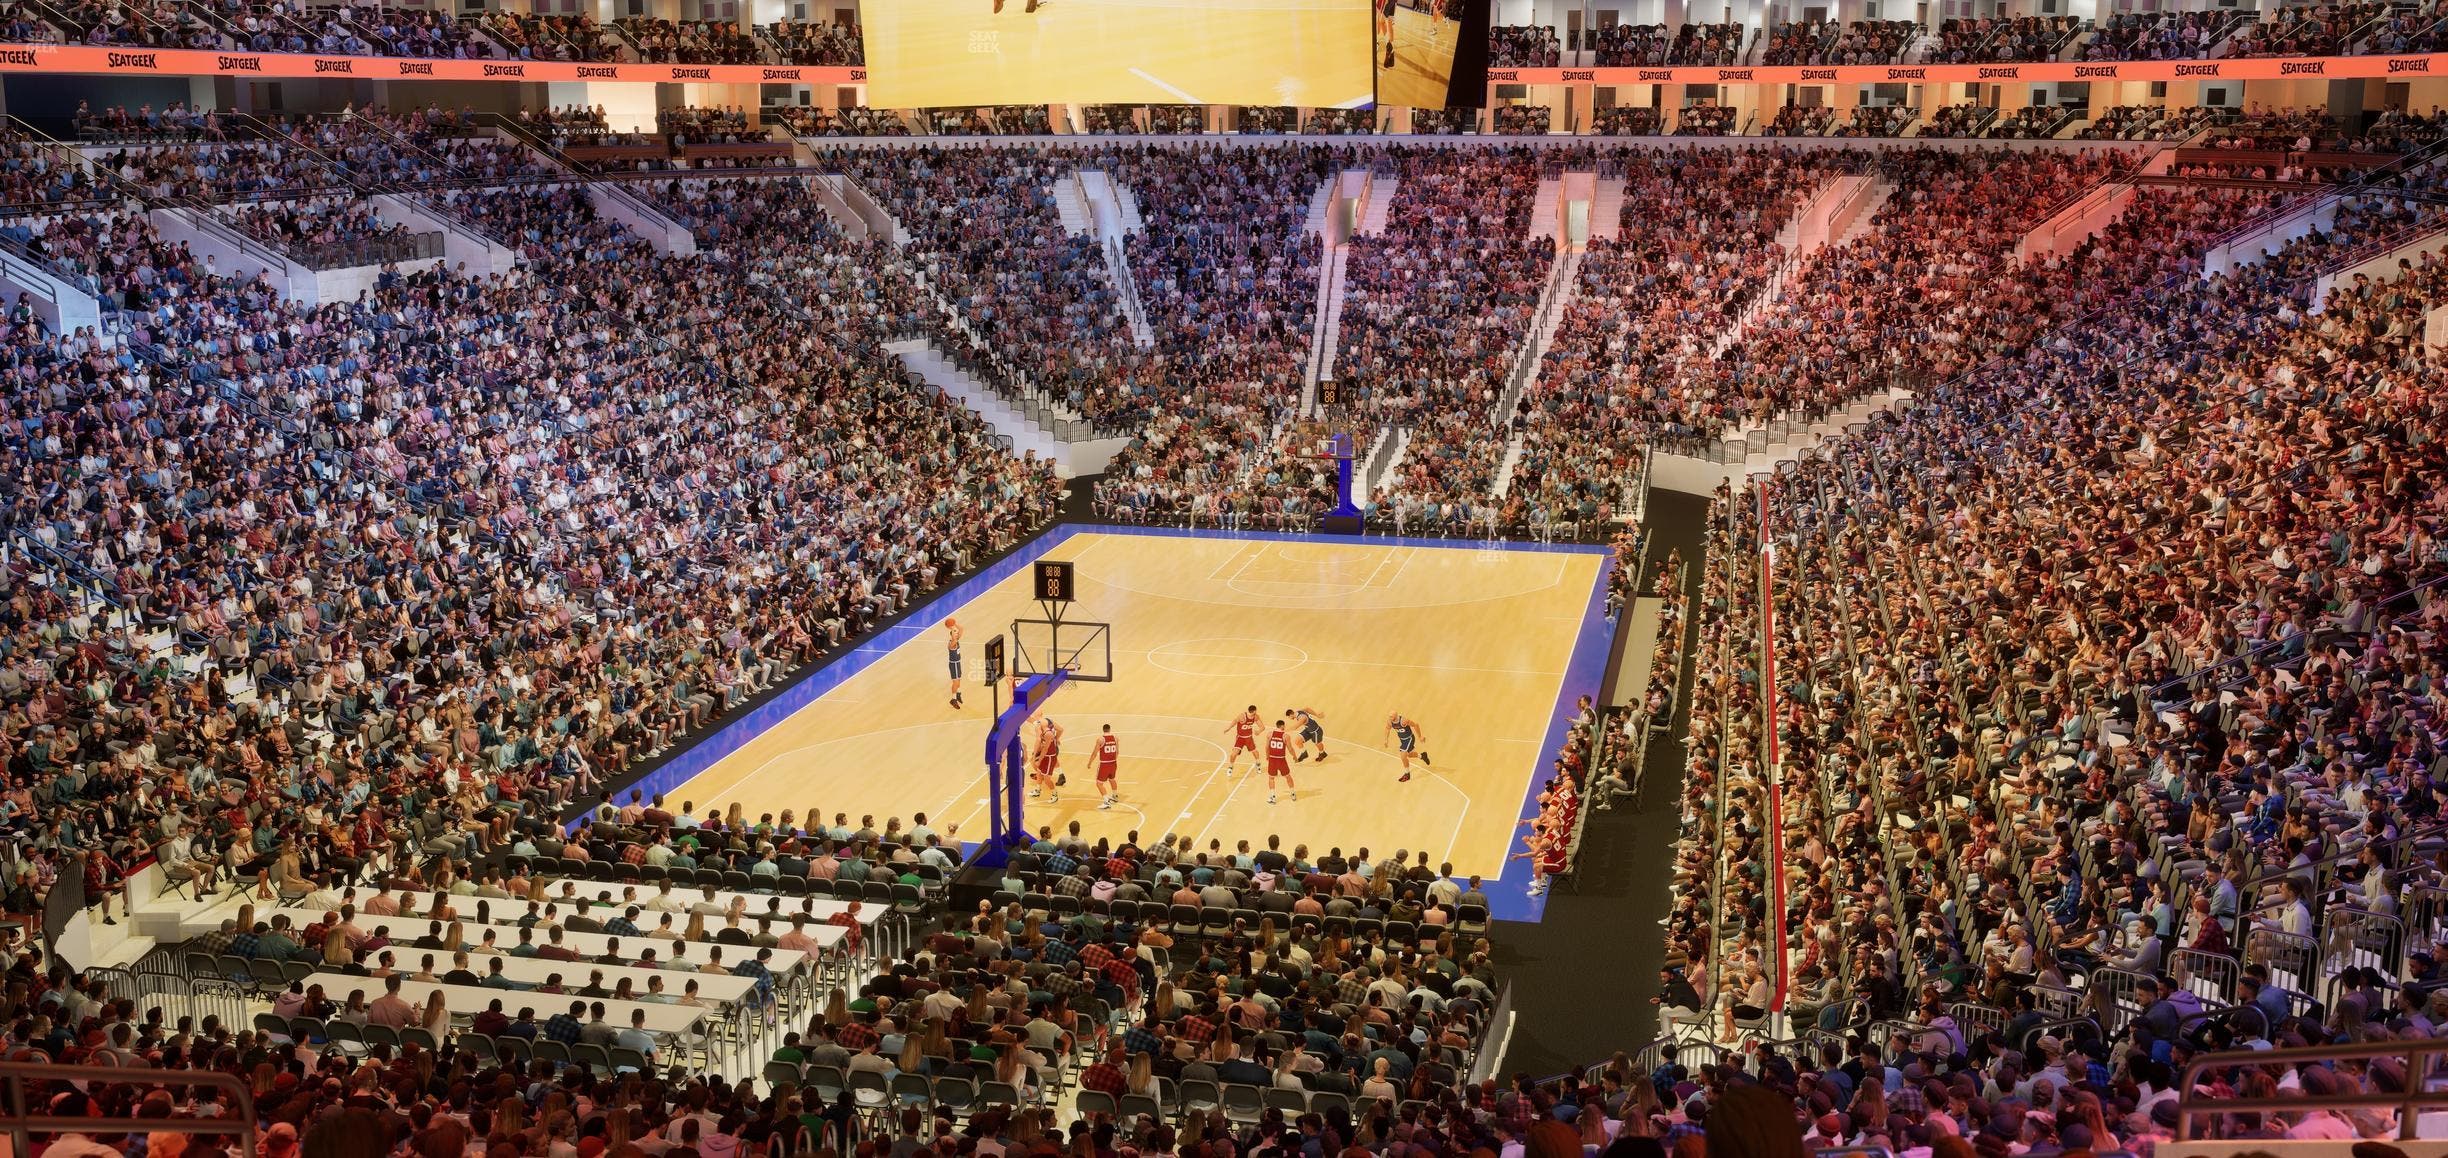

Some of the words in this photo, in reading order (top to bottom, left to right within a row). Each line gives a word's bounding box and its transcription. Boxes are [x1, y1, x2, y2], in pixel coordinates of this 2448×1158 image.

[0, 50, 37, 66] TGEEK
[108, 53, 157, 69] SEATGEEK
[219, 56, 261, 71] SEATGEEK
[315, 60, 353, 74] SEATGEEK
[400, 62, 434, 75] SEATGEEK
[484, 65, 524, 77] SEATGEEK
[2175, 64, 2219, 76] SEATGEEK
[2281, 61, 2325, 75] SEATGEEK
[2388, 58, 2430, 73] SEATGEEK
[577, 67, 617, 78] SEATGEEK
[672, 68, 711, 79] SEATGEEK
[763, 69, 801, 80] SEATGEEK
[1562, 71, 1595, 80] SEATGEEK
[1639, 71, 1673, 80] SEATGEEK
[1719, 70, 1754, 80] SEATGEEK
[1801, 69, 1838, 80] SEATGEEK
[1888, 69, 1926, 79] SEATGEEK
[1979, 67, 2019, 78] SEATGEEK
[2075, 66, 2117, 77] SEATGEEK
